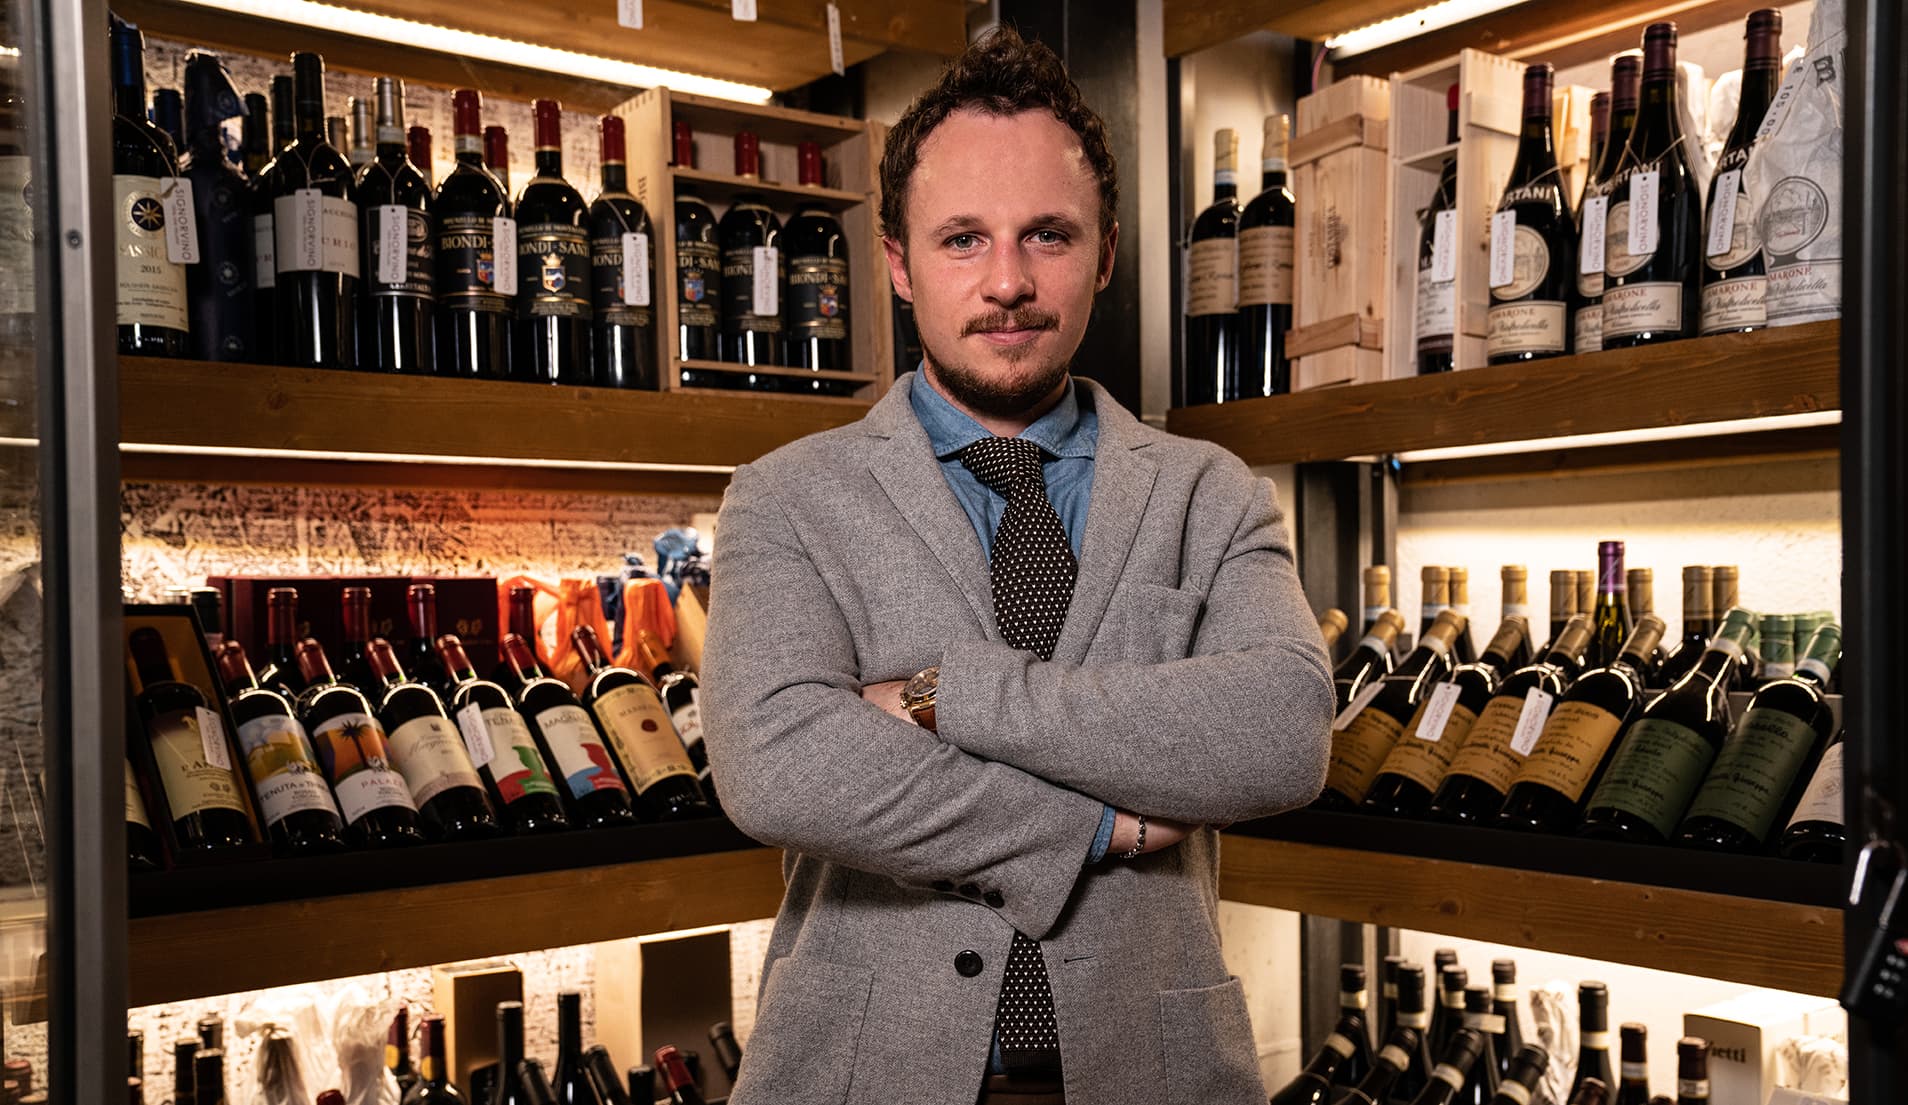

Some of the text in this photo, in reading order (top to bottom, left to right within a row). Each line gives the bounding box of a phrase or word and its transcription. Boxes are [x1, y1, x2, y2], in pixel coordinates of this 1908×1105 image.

[175, 188, 191, 260] SIGNORVINO
[307, 199, 316, 266] SIGNORVINO
[391, 215, 401, 280] SIGNORVINO
[1592, 206, 1603, 269] SIGNORVINO
[1640, 184, 1650, 251] SIGNORVINO
[1717, 181, 1733, 250] SIGNORVINO
[141, 264, 162, 275] 2015
[1707, 1041, 1746, 1063] ietti
